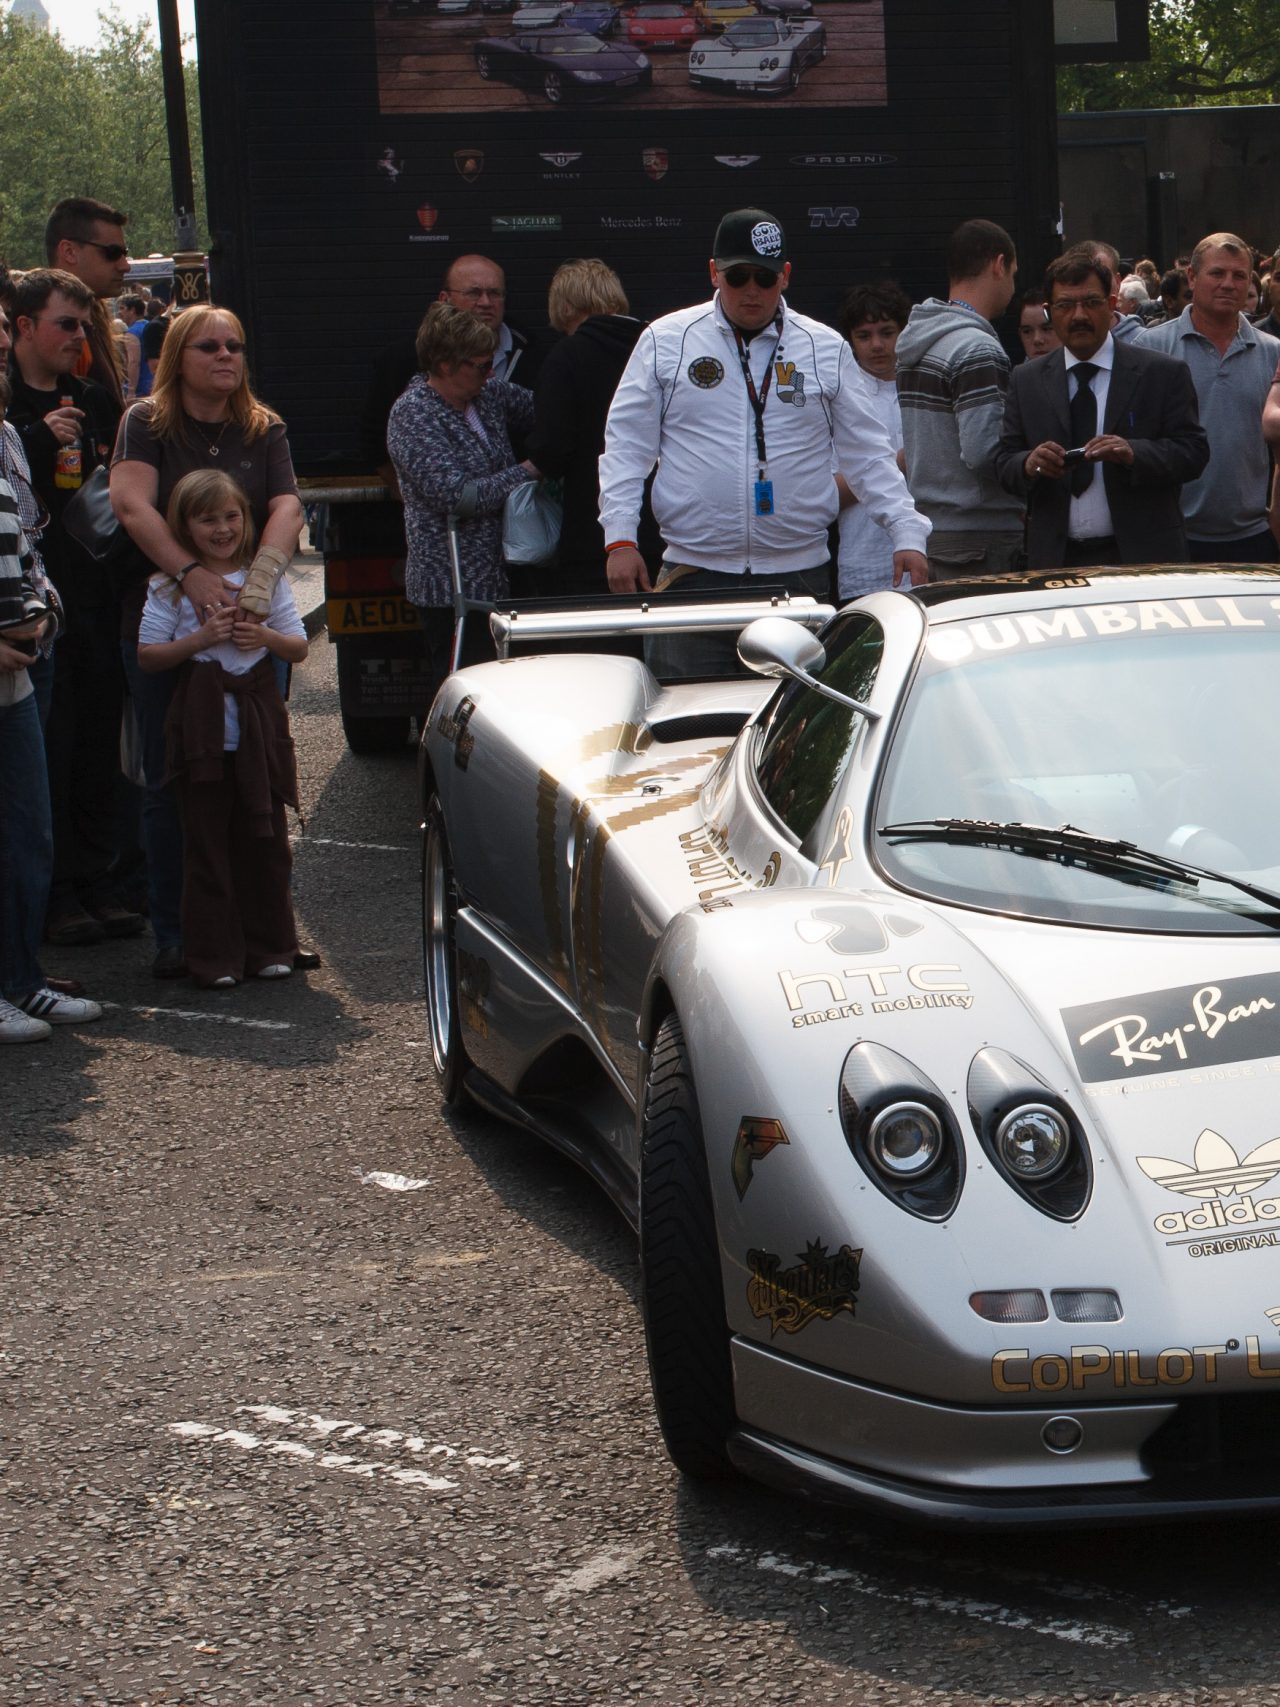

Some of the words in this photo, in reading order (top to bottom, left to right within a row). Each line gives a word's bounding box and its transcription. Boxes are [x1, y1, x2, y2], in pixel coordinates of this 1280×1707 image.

[805, 155, 883, 164] PAGANI
[543, 172, 581, 180] BENTLEY
[512, 216, 556, 230] JAGUAR
[600, 215, 652, 228] Mercedes
[807, 206, 861, 228] TVR
[343, 599, 417, 628] AE06
[792, 1001, 864, 1028] smart
[872, 993, 974, 1015] mobility
[1079, 985, 1276, 1067] Ray-Ban
[1189, 1064, 1256, 1085] SINCE
